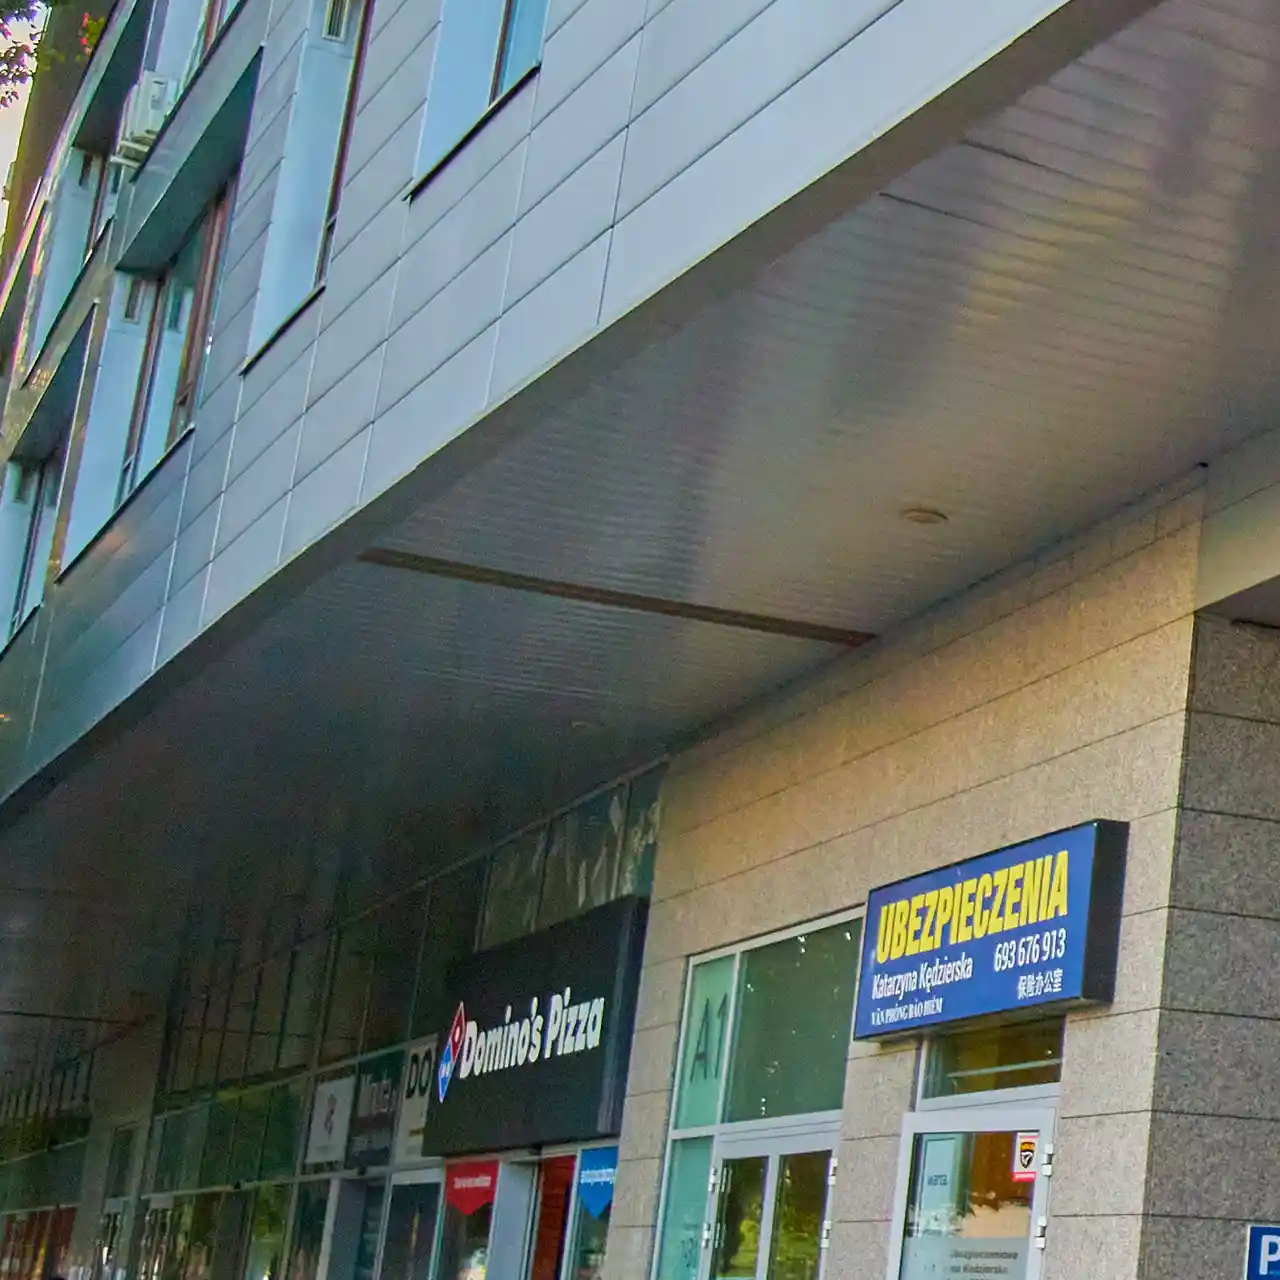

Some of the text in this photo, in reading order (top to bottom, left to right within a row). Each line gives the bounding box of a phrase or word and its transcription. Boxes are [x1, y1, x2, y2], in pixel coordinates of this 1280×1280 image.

[876, 850, 1069, 964] UBEZPIECZENIA
[994, 927, 1066, 972] 693 676 913
[871, 952, 974, 1000] Katarzyna Kędzierska
[459, 986, 605, 1080] Domino's Pizza
[690, 991, 728, 1083] A1
